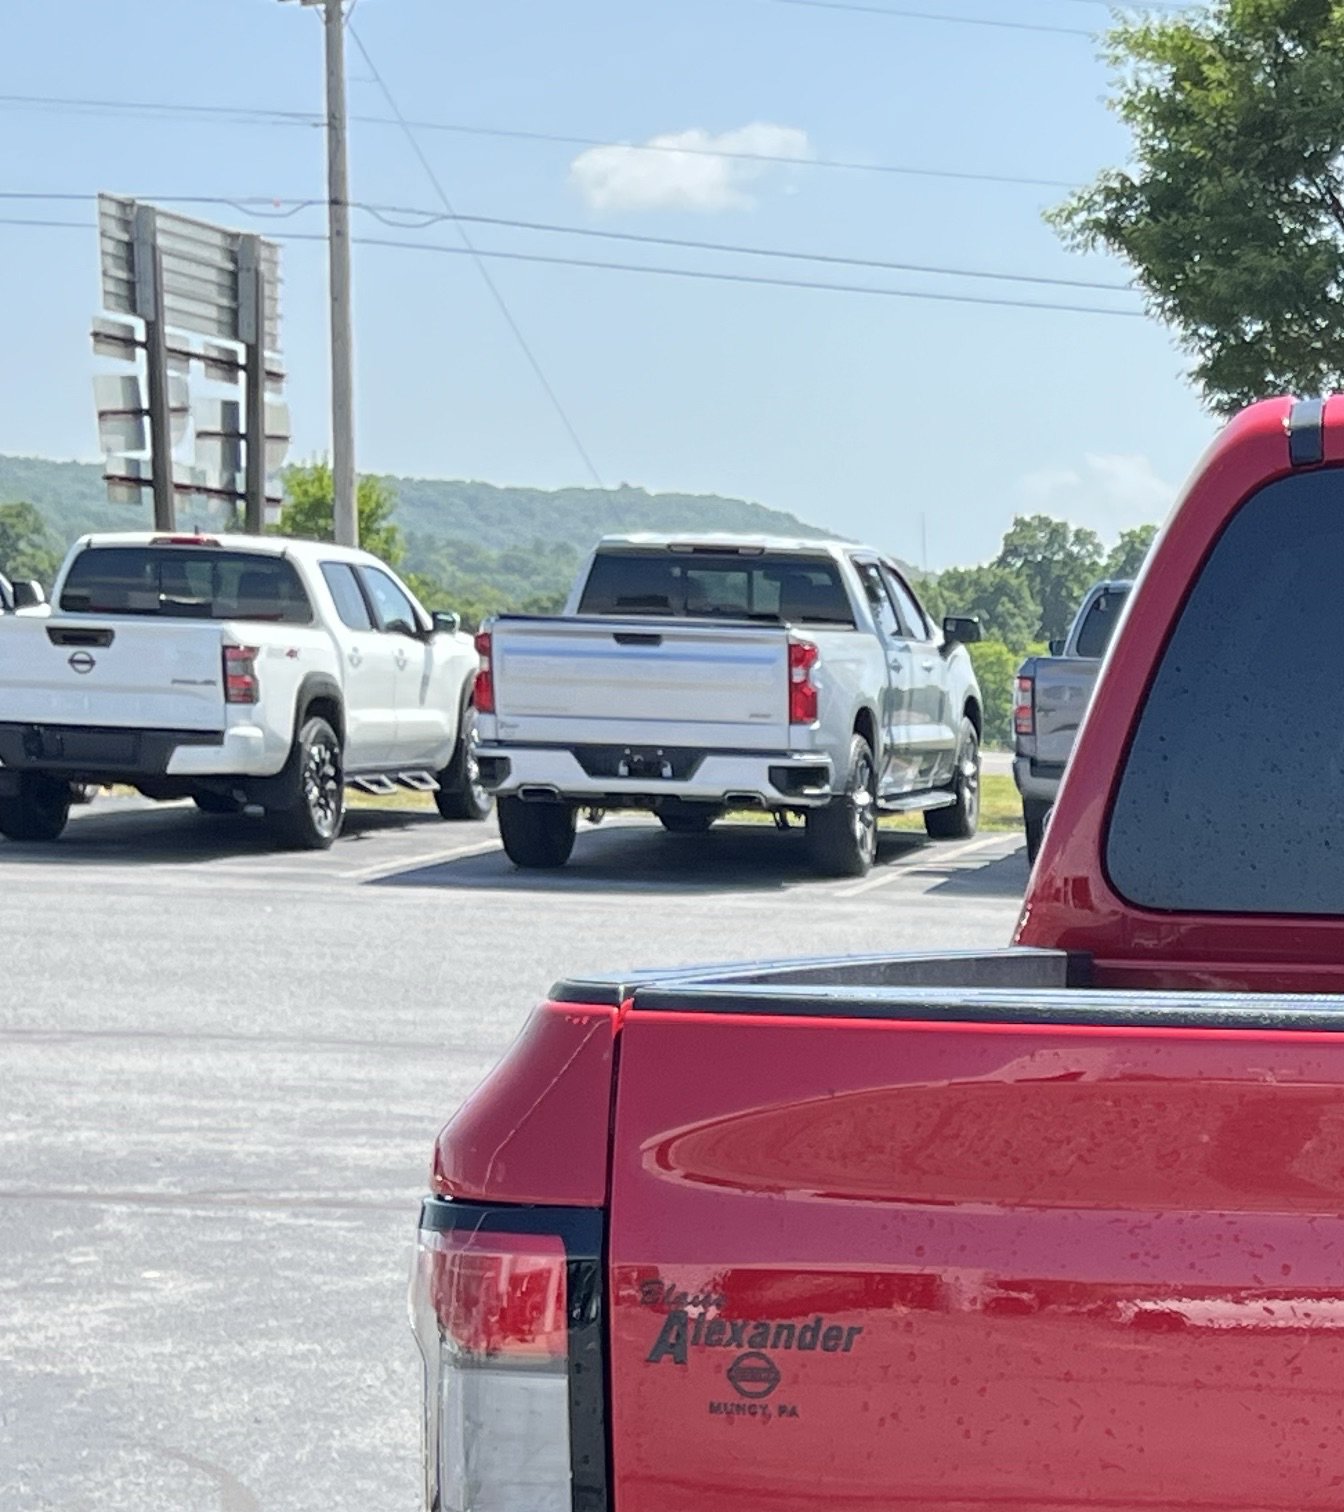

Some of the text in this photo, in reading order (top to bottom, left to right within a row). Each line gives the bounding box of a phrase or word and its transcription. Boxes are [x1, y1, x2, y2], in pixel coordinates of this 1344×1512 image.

[640, 1279, 726, 1310] Bla
[646, 1310, 863, 1364] Alexander
[709, 1401, 799, 1420] MUNCY, PA
